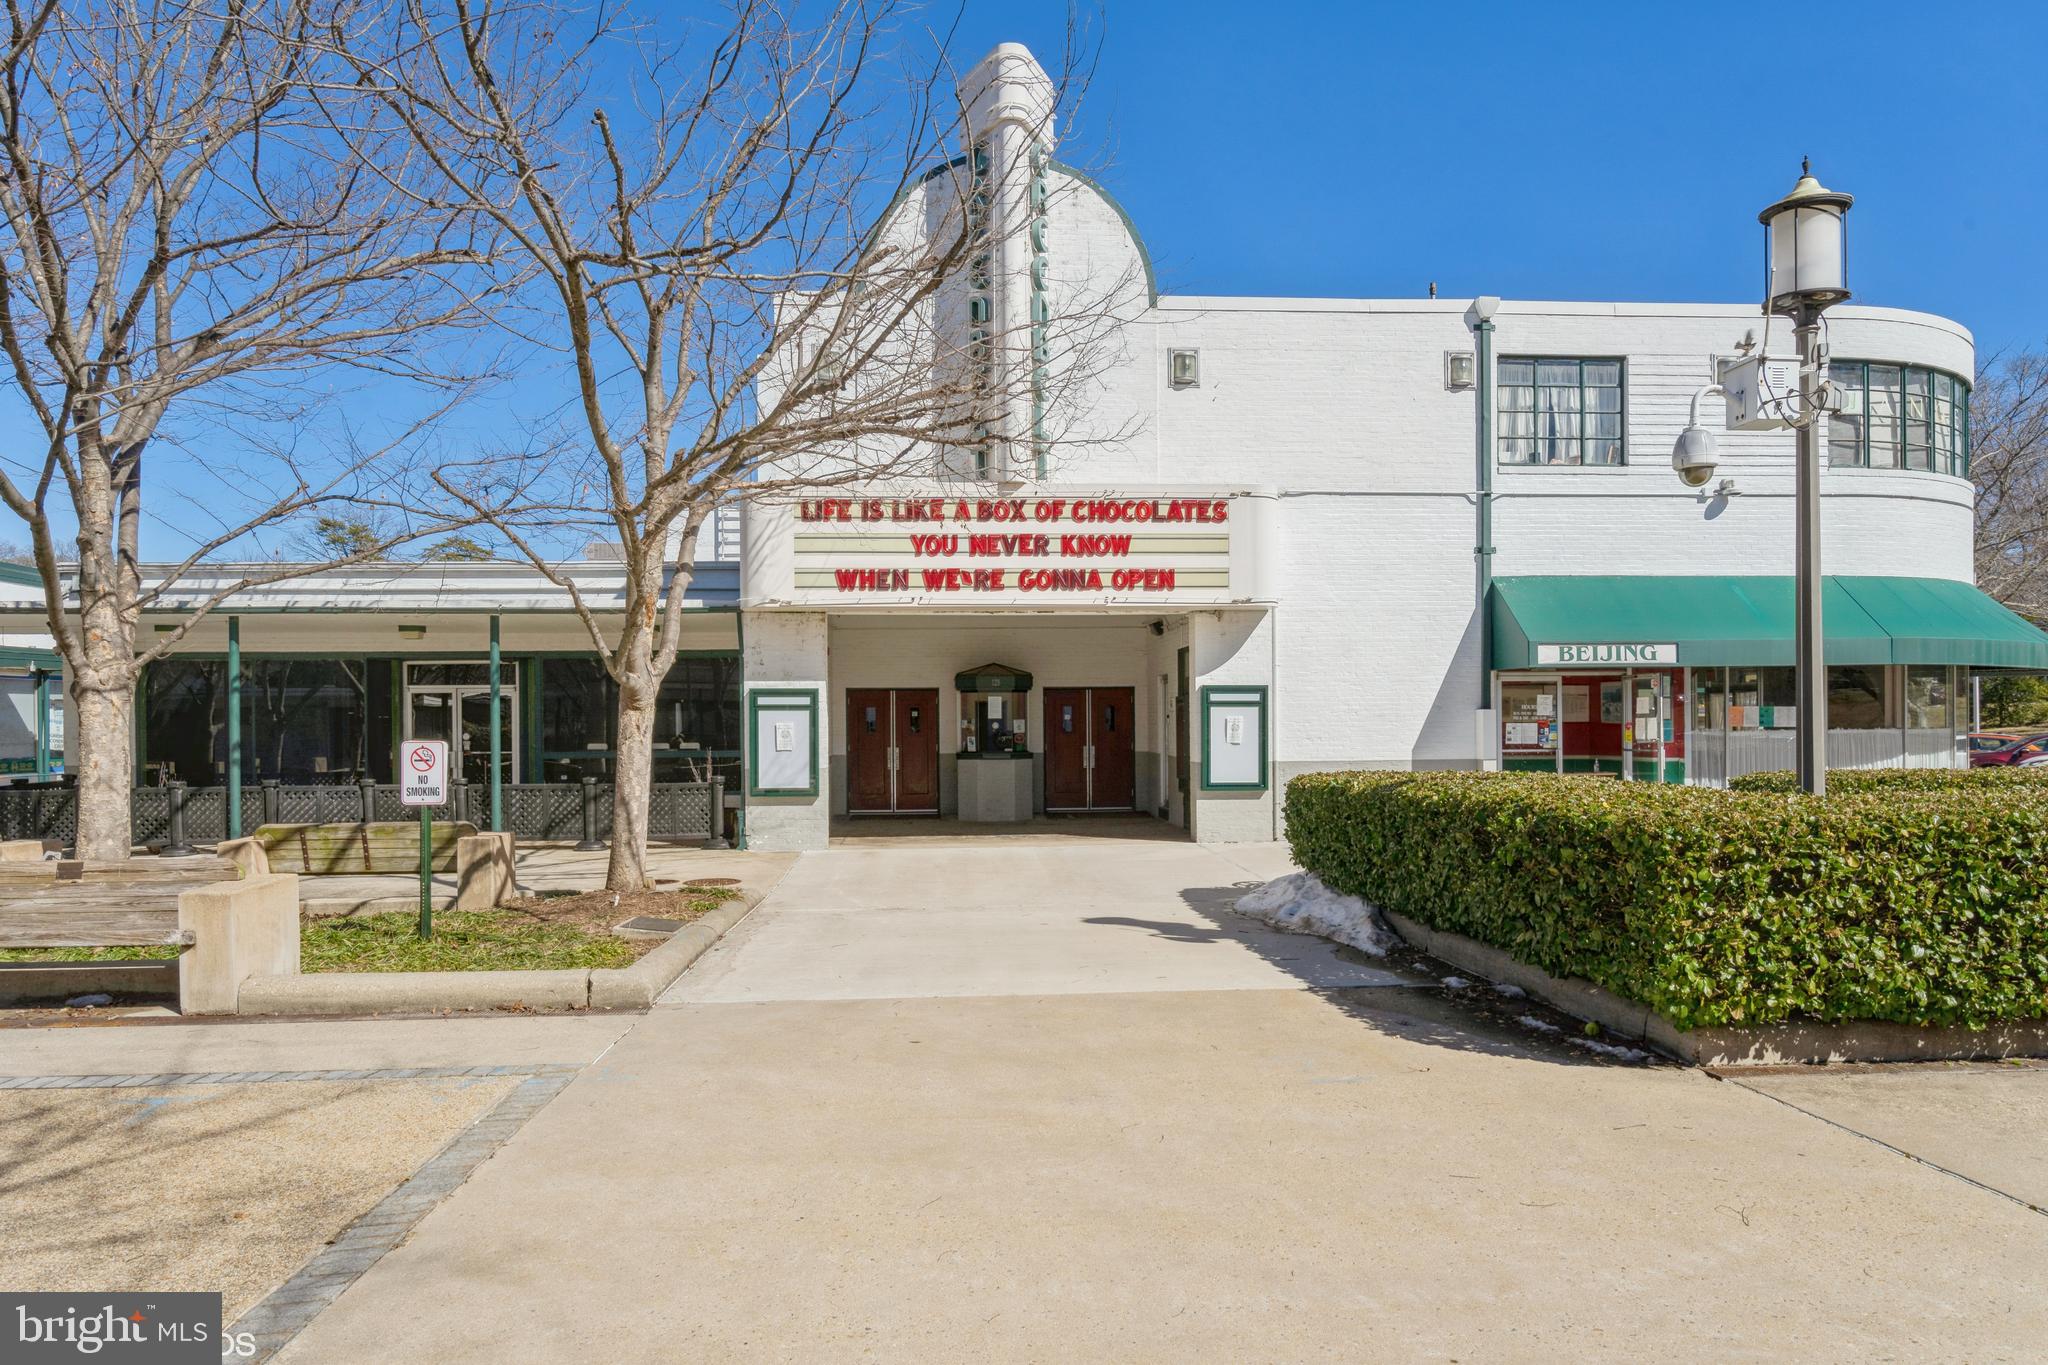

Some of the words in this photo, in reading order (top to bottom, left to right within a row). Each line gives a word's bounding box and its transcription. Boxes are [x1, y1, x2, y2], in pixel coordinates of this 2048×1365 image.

[800, 499, 852, 522] LIFE
[861, 499, 885, 522] IS
[892, 499, 945, 522] LIKE
[953, 499, 972, 522] A
[976, 499, 1028, 522] BOX
[1034, 499, 1066, 522] OF
[1071, 499, 1228, 523] CHOCOLATES
[910, 533, 958, 557] YOU
[969, 533, 1050, 557] NEVER
[1060, 533, 1133, 557] KNOW
[834, 568, 910, 592] WHEN
[921, 568, 1005, 592] WE'RE
[1018, 568, 1104, 592] GONNA
[1111, 568, 1176, 592] OPEN
[1559, 644, 1658, 662] BEIJING
[417, 775, 429, 785] NO
[406, 787, 440, 797] SMOKING
